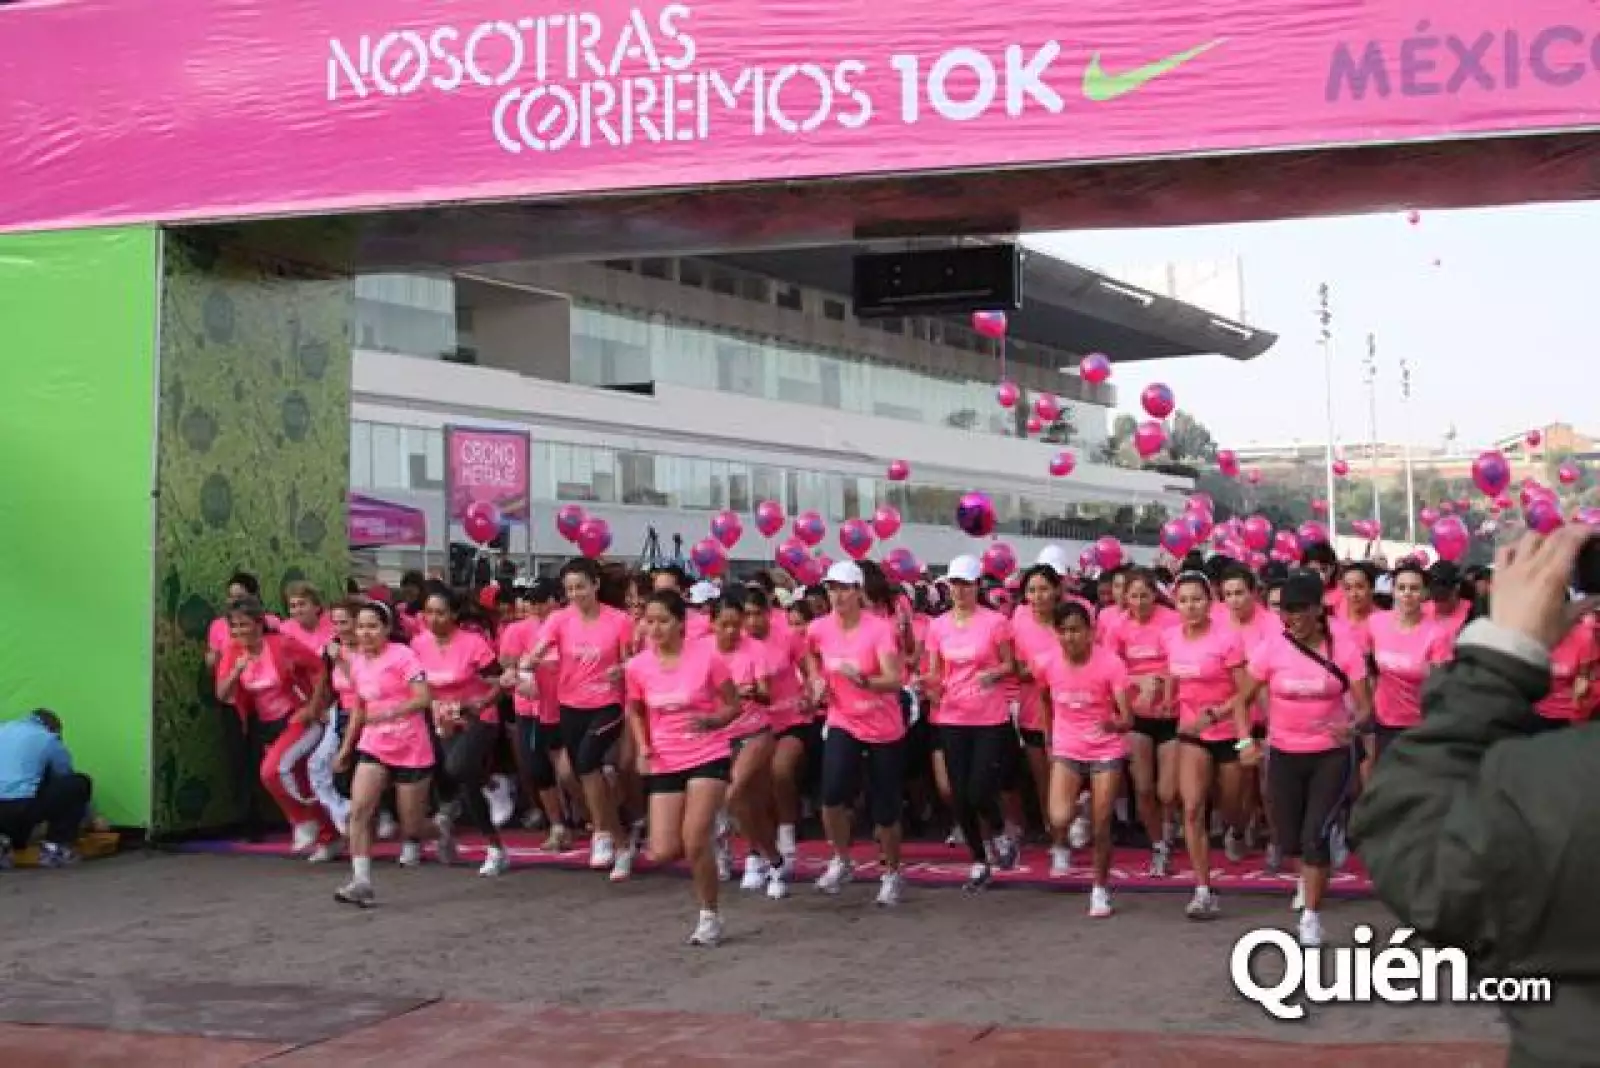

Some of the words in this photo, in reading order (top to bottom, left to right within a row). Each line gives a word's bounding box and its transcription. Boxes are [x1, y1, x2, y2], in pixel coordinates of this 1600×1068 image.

[327, 4, 697, 101] NOSOTRAS
[492, 61, 874, 153] CORREMOS
[890, 39, 1065, 124] 10K
[1325, 20, 1600, 101] MÉXIC
